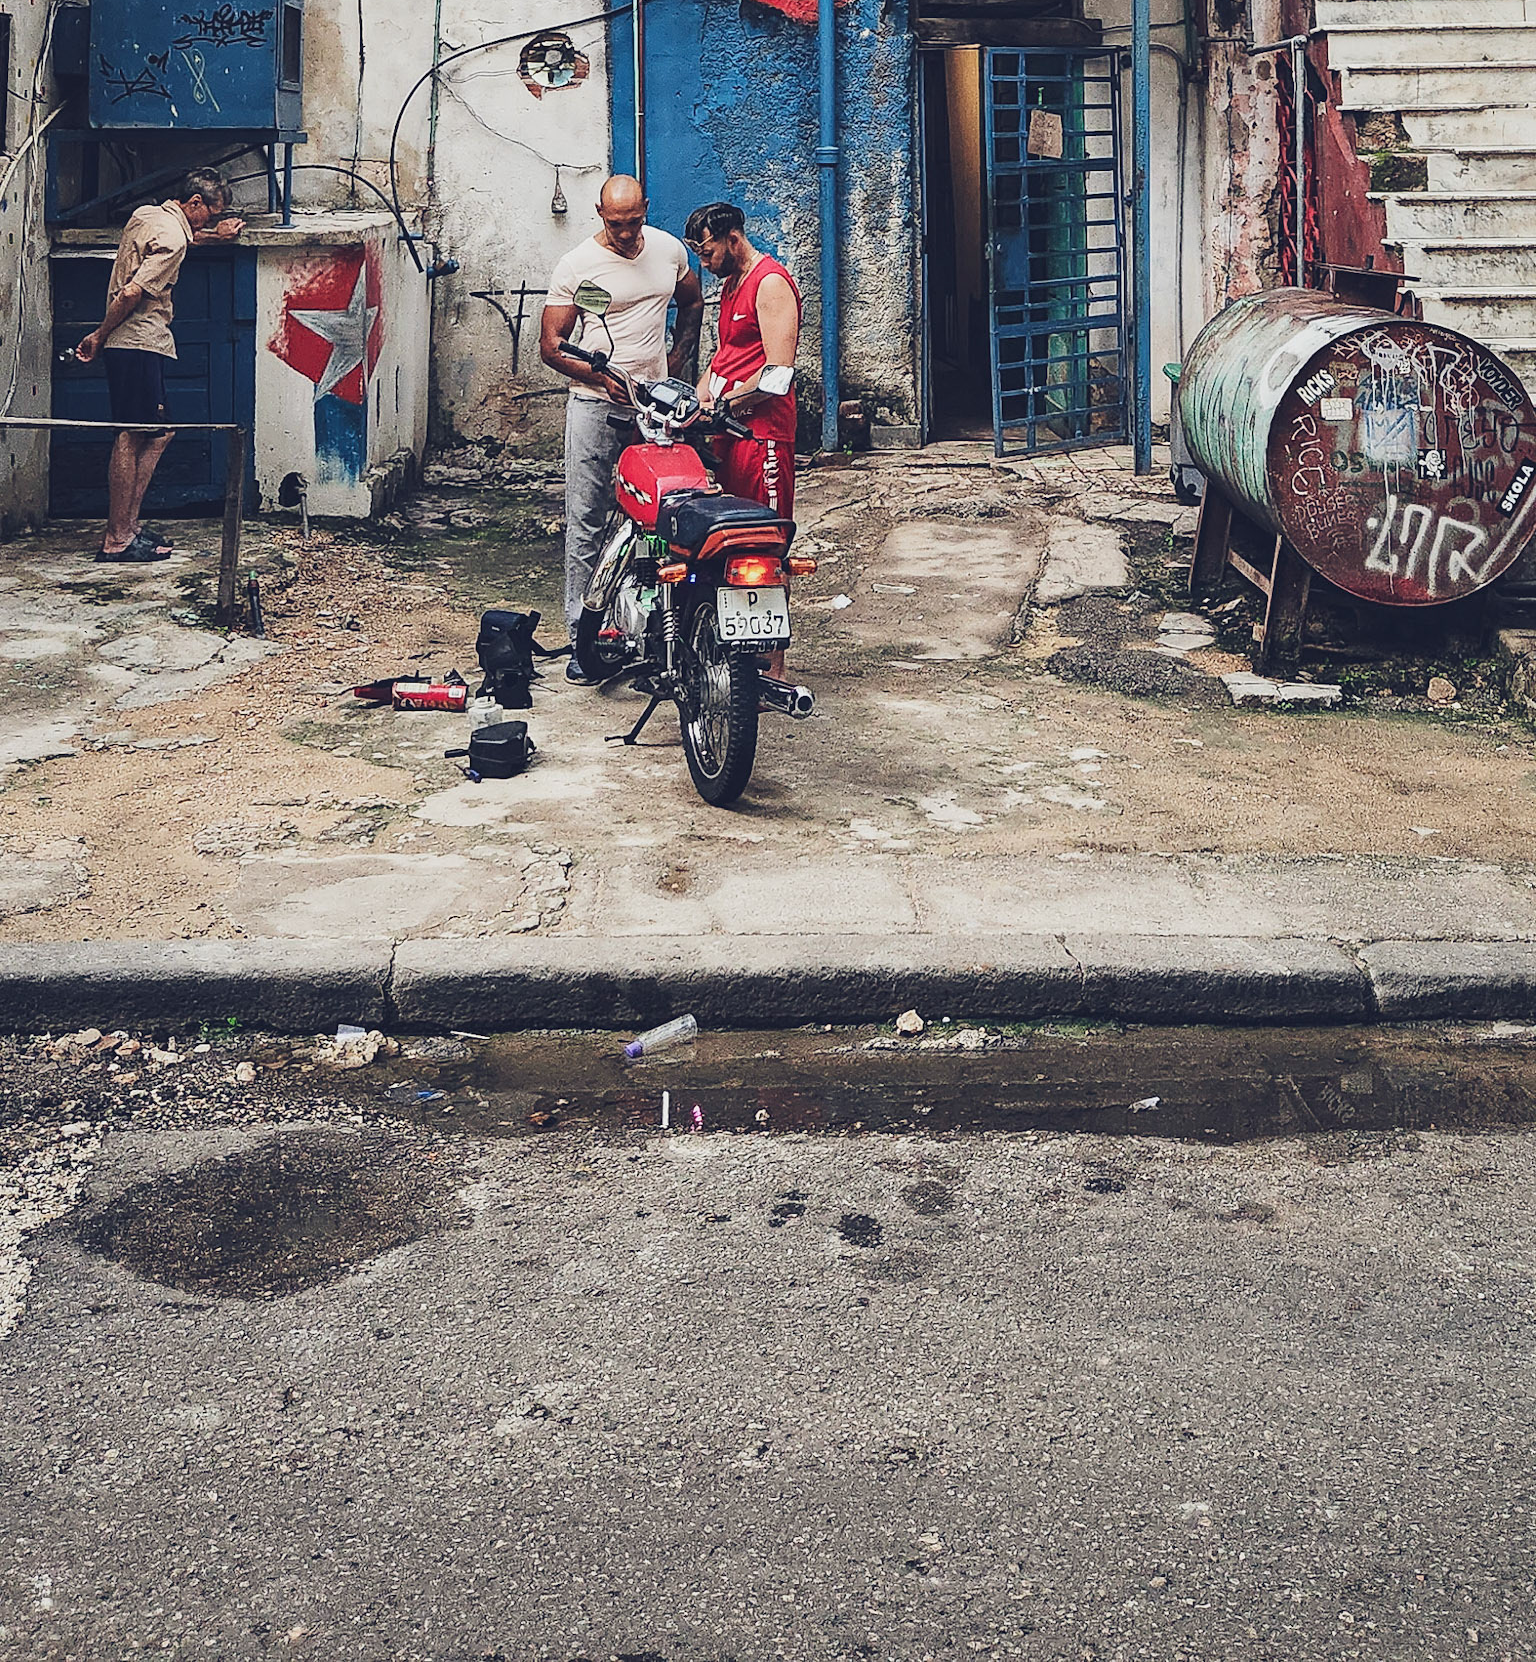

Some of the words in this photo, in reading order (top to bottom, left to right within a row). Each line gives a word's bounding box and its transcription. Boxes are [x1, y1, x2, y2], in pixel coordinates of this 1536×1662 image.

[1296, 368, 1336, 407] RICKS
[1480, 359, 1523, 409] VOYDER
[1501, 465, 1535, 512] SKOLA
[747, 591, 758, 608] P
[725, 614, 784, 636] 59037
